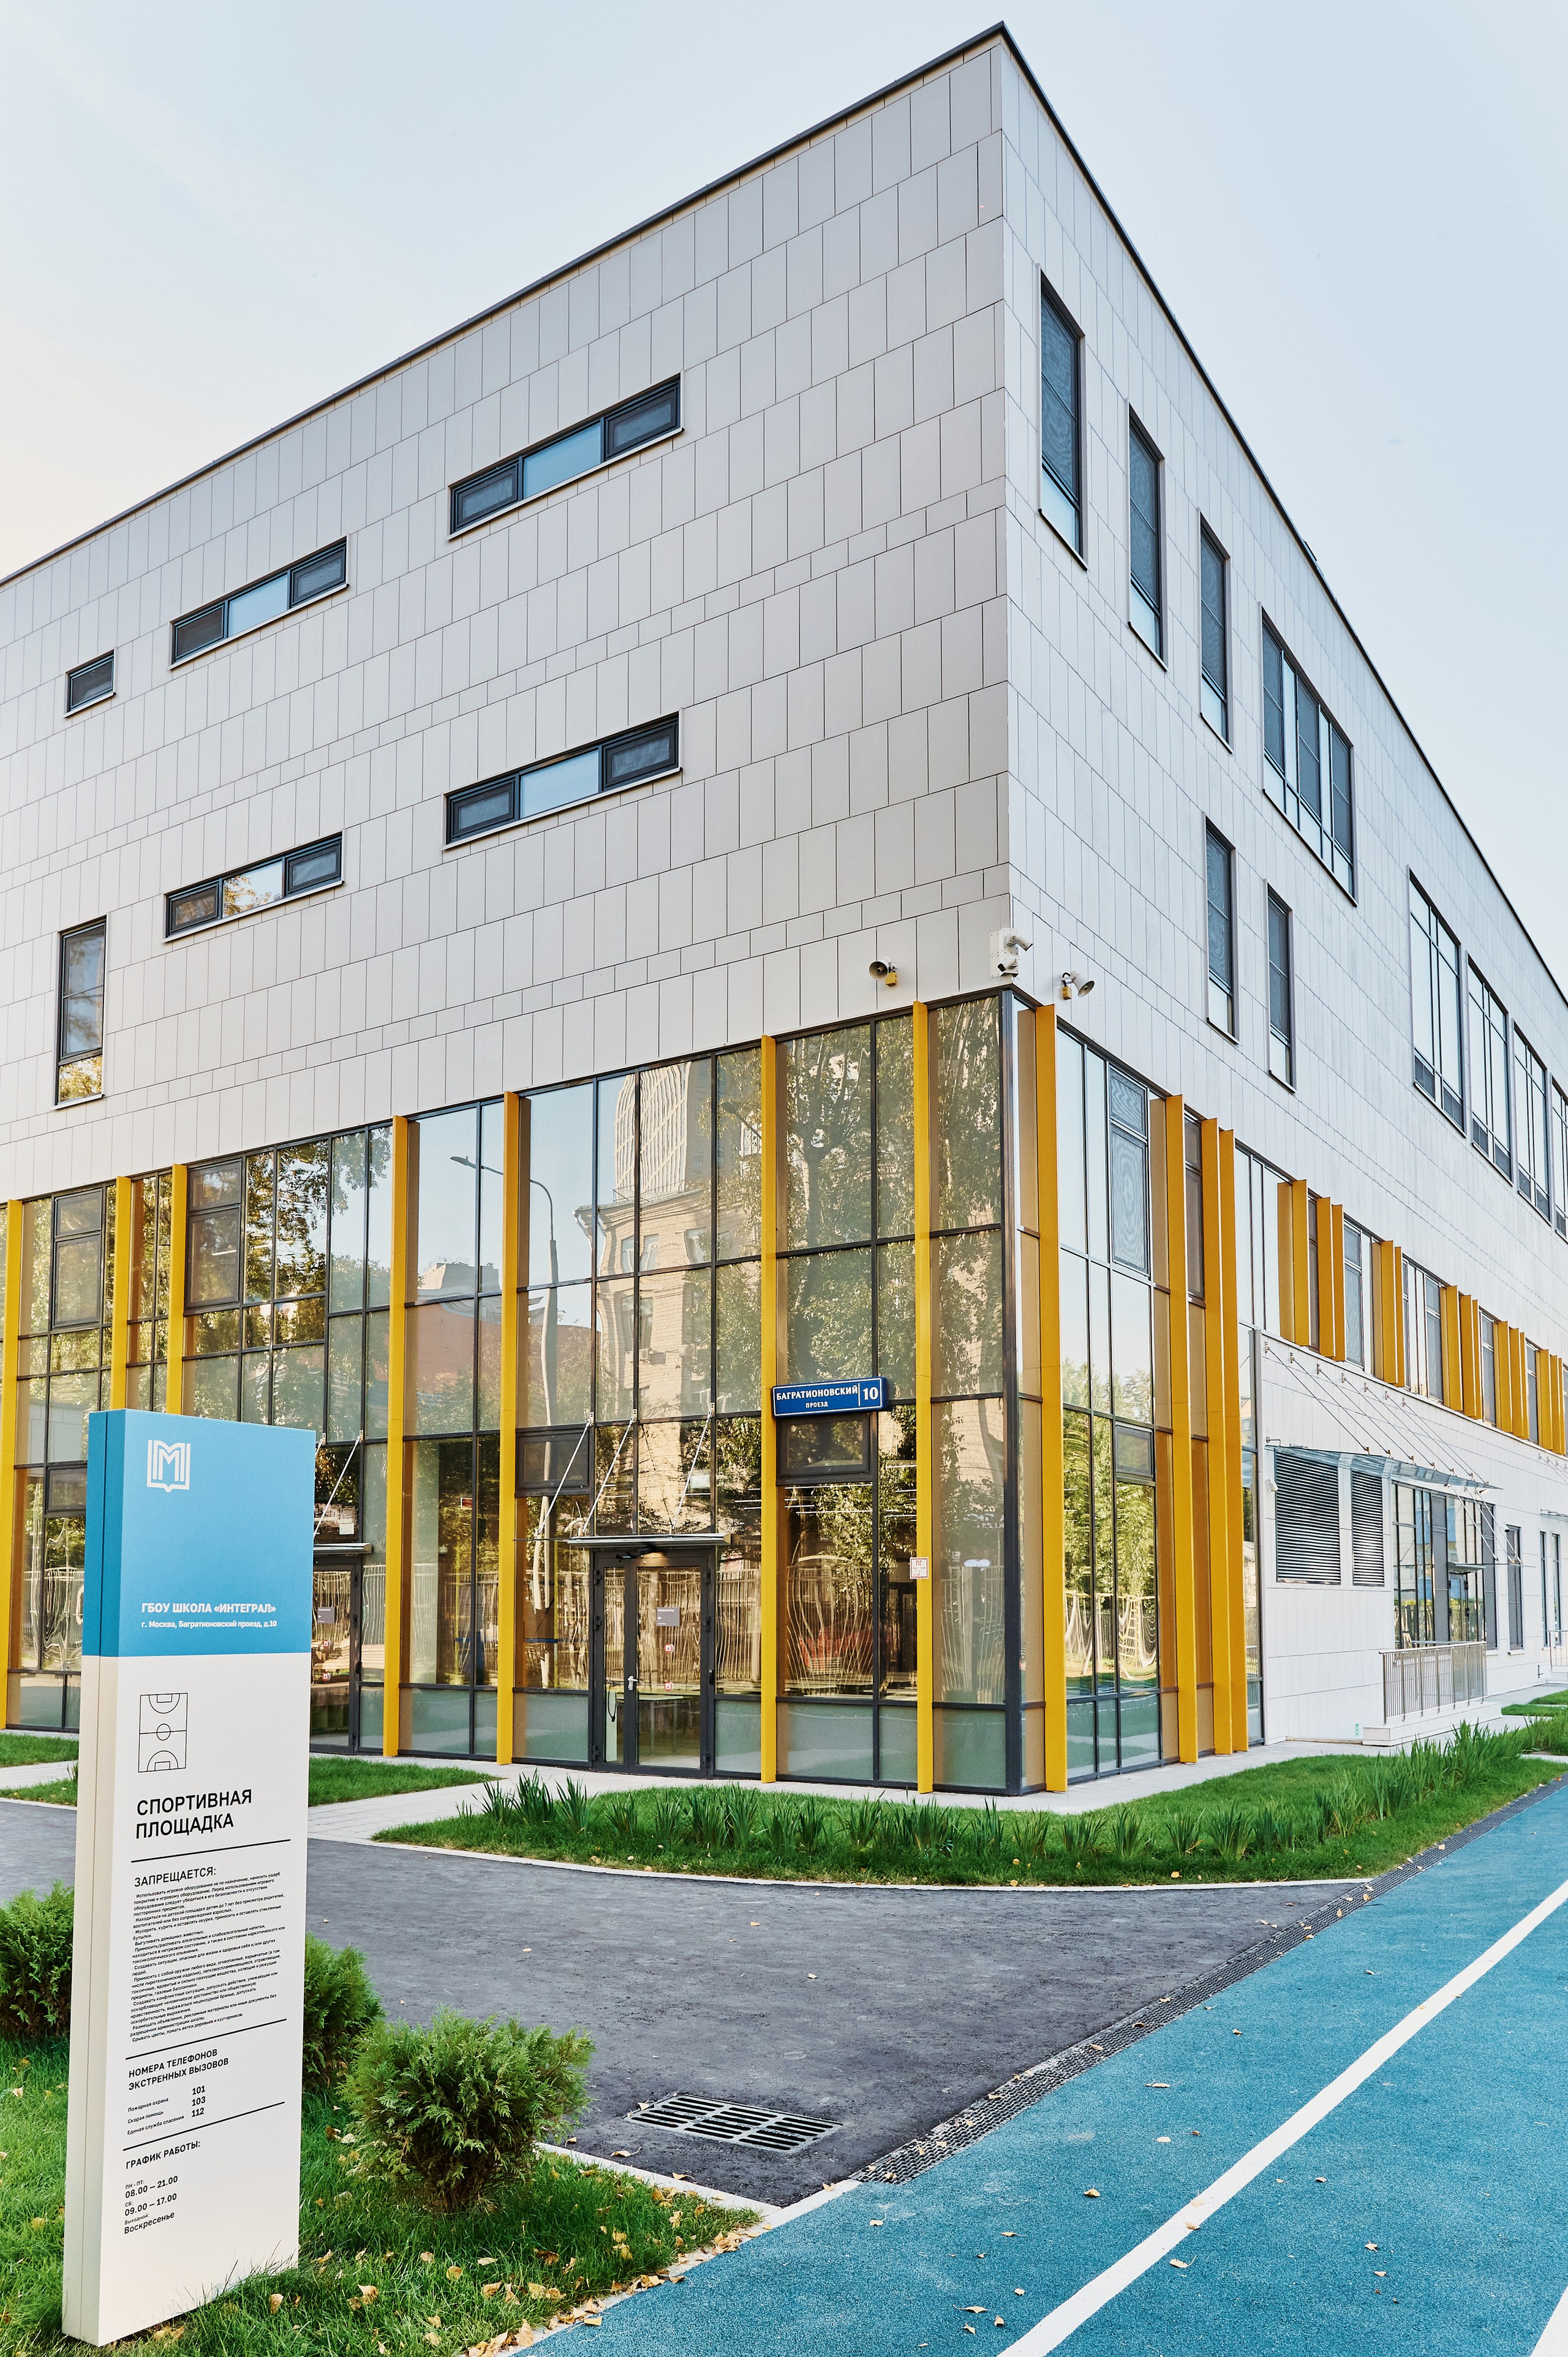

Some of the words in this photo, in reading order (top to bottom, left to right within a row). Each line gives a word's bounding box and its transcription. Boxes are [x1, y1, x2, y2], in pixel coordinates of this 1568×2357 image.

[776, 1385, 858, 1400] БАГРАТИОНОВСКИЙ
[862, 1387, 879, 1400] 10
[141, 1602, 170, 1613] ГБОУ
[172, 1603, 212, 1613] ШКОЛА
[214, 1604, 276, 1613] «ИНТЕГРАЛ»
[179, 1620, 237, 1629] Багратионовский
[137, 1789, 251, 1816] СПОРТИВНАЯ
[136, 1812, 234, 1839] ПЛОЩАДКА
[134, 1866, 216, 1887] ЗАПРЕЩАЕТСЯ:
[129, 2062, 164, 2078] НОМЕРА
[167, 2048, 217, 2068] ТЕЛЕФОНОВ
[129, 2068, 187, 2090] ЭКСТРЕННЫХ
[189, 2057, 228, 2075] ВЫЗОВОВ
[192, 2085, 205, 2095] 101
[127, 2102, 151, 2112] Пожарная
[192, 2095, 205, 2106] 103
[191, 2107, 204, 2118] 112
[145, 2121, 162, 2130] служба
[163, 2115, 184, 2124] спасения
[126, 2151, 161, 2169] ГРАФИК
[164, 2140, 200, 2157] РАБОТЫ:
[125, 2185, 148, 2198] 08.00
[157, 2175, 178, 2188] 21.00
[124, 2203, 147, 2216] 09.00
[156, 2193, 176, 2206] 17.00
[124, 2213, 149, 2225] Выходной:
[124, 2212, 175, 2234] Воскресенье
